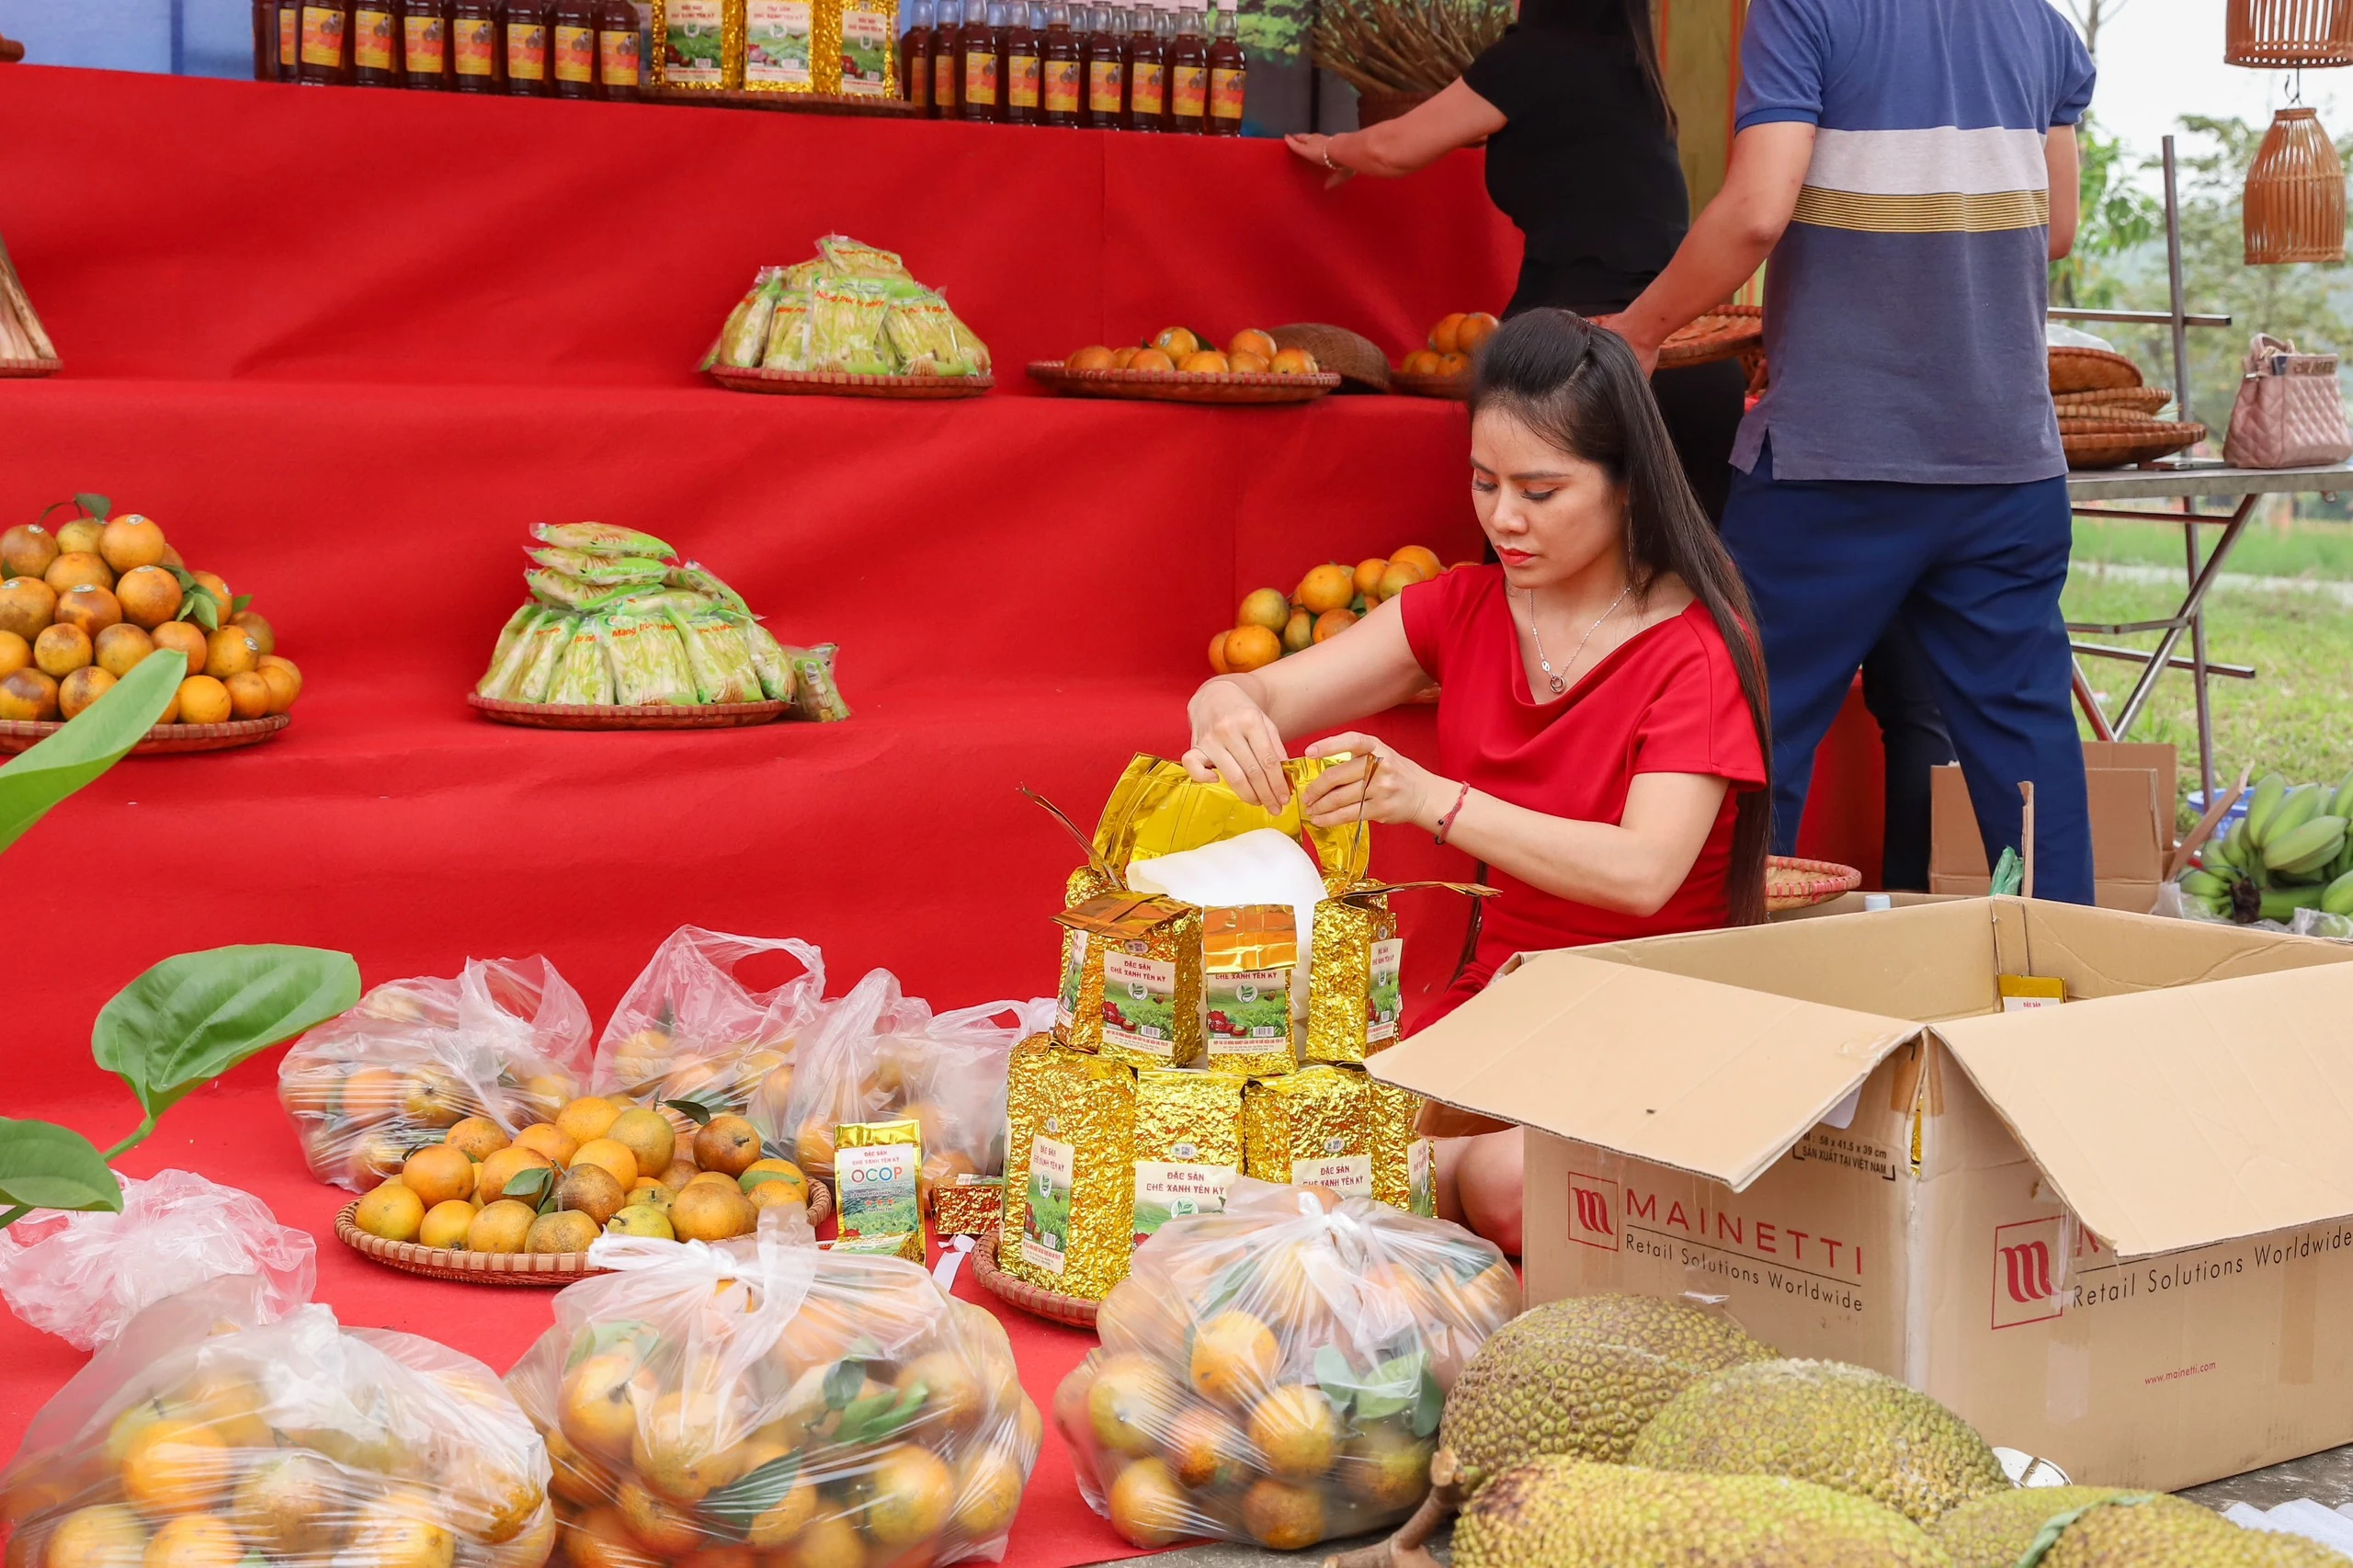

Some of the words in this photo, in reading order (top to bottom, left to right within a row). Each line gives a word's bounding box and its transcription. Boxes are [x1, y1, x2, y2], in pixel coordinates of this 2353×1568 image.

[1110, 966, 1122, 974] CHÈ
[1124, 970, 1142, 979] XANH
[1142, 972, 1155, 981] YÊN
[1124, 960, 1137, 969] ĐẶC
[1138, 962, 1152, 971] SẢN
[1819, 1135, 1829, 1146] 58
[1837, 1139, 1854, 1152] 41.5
[1862, 1144, 1872, 1156] 39
[1874, 1149, 1887, 1159] cm
[1802, 1143, 1817, 1159] SẢN
[1818, 1148, 1838, 1164] XUẤT
[1839, 1153, 1851, 1168] TẠI
[1852, 1156, 1869, 1171] VIỆT
[1870, 1162, 1887, 1175] NAM
[851, 1166, 903, 1184] OCOP
[1166, 1170, 1185, 1181] ĐẶC
[1188, 1171, 1205, 1182] SẢN
[1320, 1165, 1335, 1176] ĐẶC
[1336, 1164, 1350, 1175] SẢN
[1146, 1181, 1164, 1192] CHÈ
[1166, 1184, 1191, 1193] XANH
[1193, 1184, 1210, 1195] YÊN
[1212, 1185, 1225, 1195] KỲ
[1341, 1176, 1355, 1187] YÊN
[1355, 1175, 1364, 1184] KỲ
[1627, 1187, 1861, 1275] MAINETTI
[1626, 1233, 1672, 1261] Retail
[1681, 1247, 1759, 1284] Solutions
[1768, 1270, 1862, 1312] Worldwide
[2073, 1272, 2136, 1309] Retail
[2147, 1258, 2243, 1293] Solutions
[2255, 1225, 2352, 1268] Worldwide
[2144, 1361, 2216, 1385] www.mainetti.com
